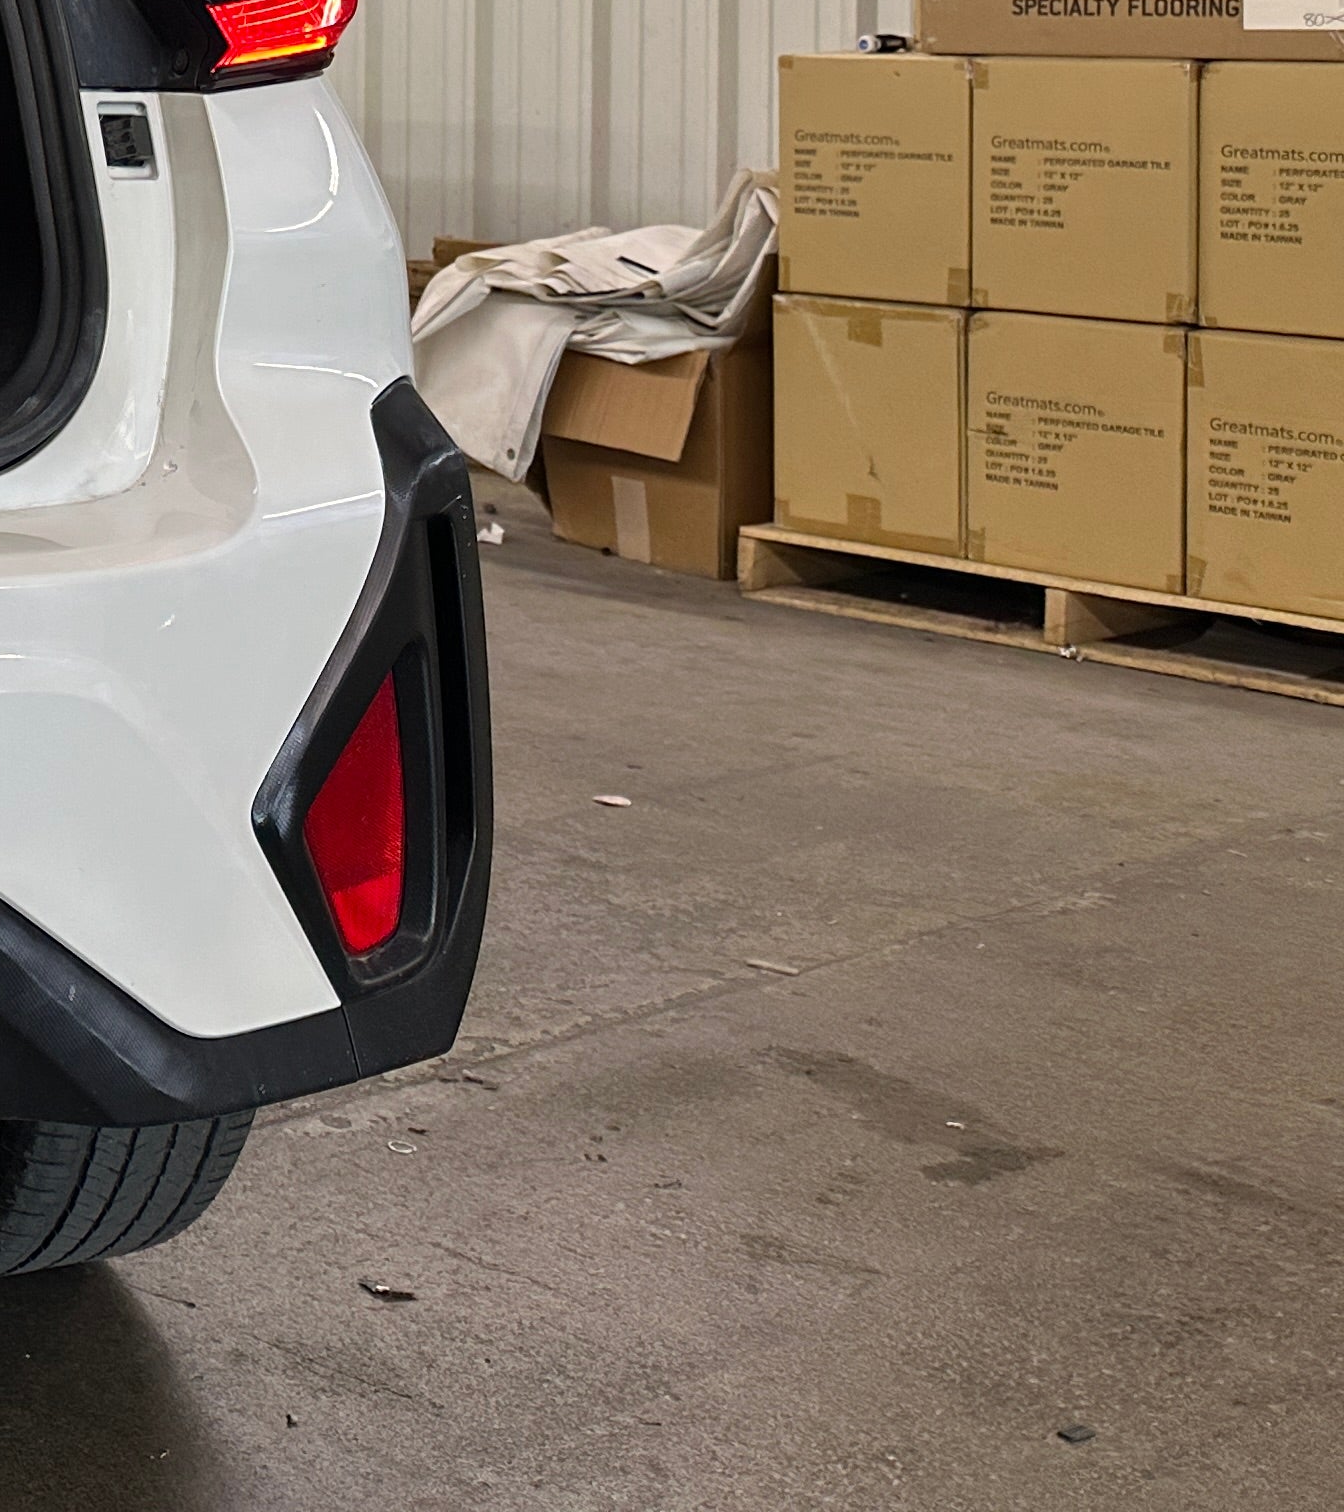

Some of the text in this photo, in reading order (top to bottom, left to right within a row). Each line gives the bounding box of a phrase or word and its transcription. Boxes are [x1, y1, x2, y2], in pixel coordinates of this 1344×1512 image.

[1043, 157, 1105, 168] PERFORATED
[1107, 161, 1148, 169] GARAGE
[1150, 161, 1171, 170] TILE
[1220, 165, 1248, 174] NAME
[1220, 193, 1307, 206] COLOR GRAY
[991, 206, 1008, 215] LOT
[1220, 206, 1270, 216] QUANTITY
[1220, 220, 1239, 228] LOT
[1220, 232, 1248, 241] MADE
[1264, 235, 1302, 245] TAIWAN
[1038, 417, 1099, 431] PERFORATED
[1102, 425, 1142, 436] GARAGE
[1144, 428, 1164, 438] TILE
[1210, 417, 1335, 445] Greatmats.com
[1209, 439, 1238, 449] NAME
[1268, 445, 1338, 461] PERFORATED
[986, 461, 1003, 471] LOT
[1209, 465, 1296, 484] COLOR GRAY
[1208, 479, 1259, 492] QUANTITY
[1208, 492, 1228, 502] LOT
[1209, 504, 1237, 516] MADE
[1253, 510, 1291, 523] TAIWAN
